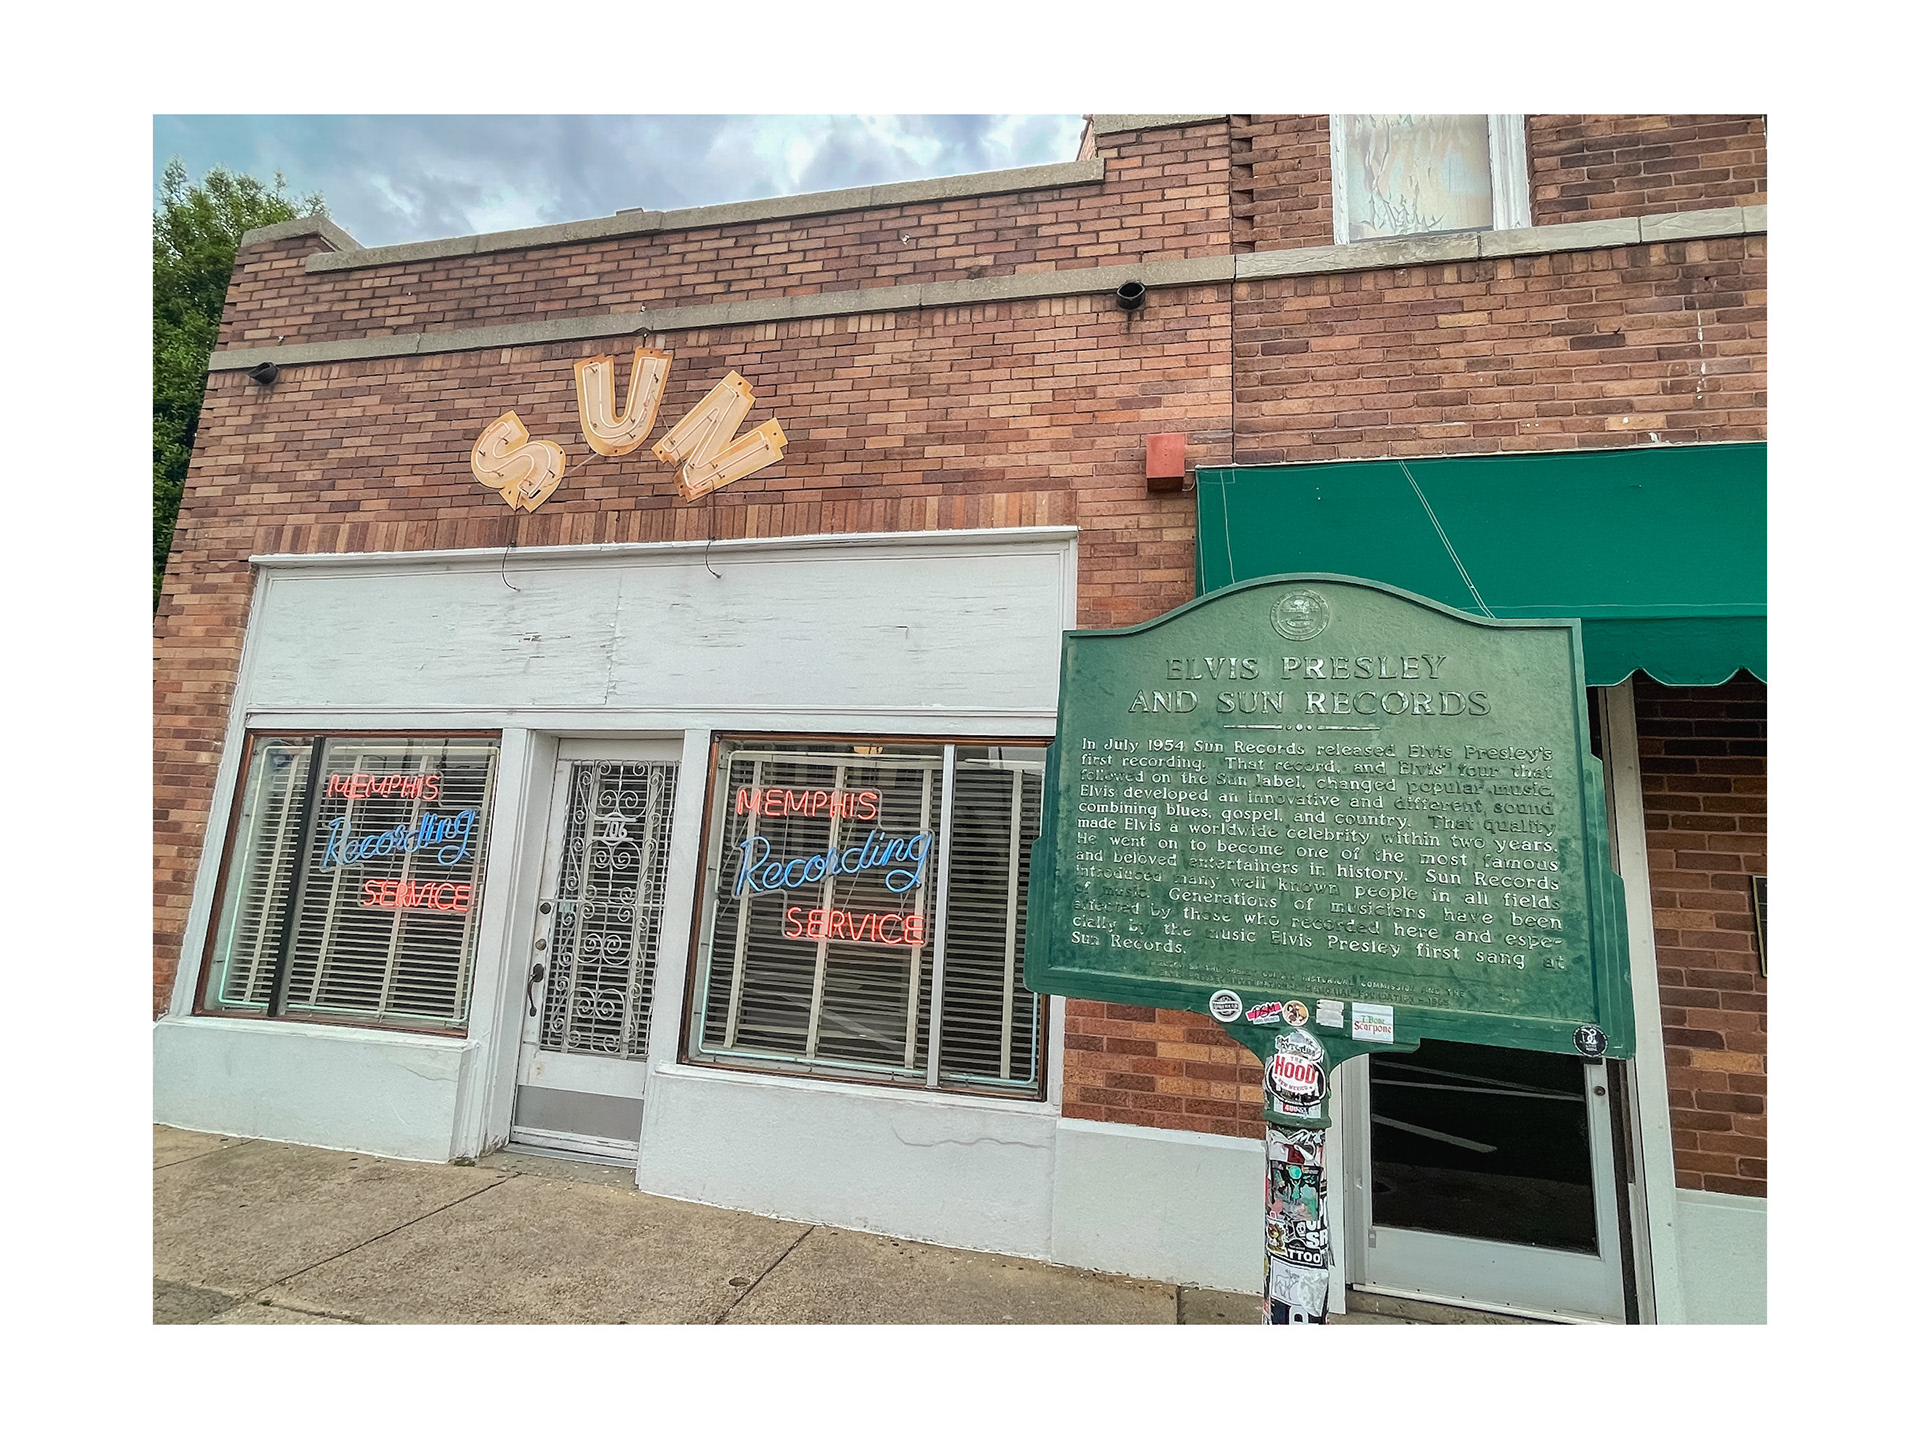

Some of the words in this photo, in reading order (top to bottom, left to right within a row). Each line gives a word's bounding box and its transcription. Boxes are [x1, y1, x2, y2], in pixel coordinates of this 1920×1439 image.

[471, 348, 788, 513] SUN
[1166, 657, 1260, 680] ELVIS
[1281, 654, 1447, 680] PRESLEY
[1128, 689, 1198, 713] AND
[1217, 690, 1284, 714] SUN
[1305, 690, 1491, 716] RECORDS
[1081, 754, 1112, 765] first
[1122, 756, 1206, 771] recording.
[1225, 757, 1264, 771] That
[1354, 761, 1386, 774] and
[1458, 763, 1499, 778] four
[1512, 764, 1553, 779] that
[1082, 738, 1096, 751] In
[1104, 739, 1139, 753] July
[1148, 740, 1185, 752] 1954
[1194, 741, 1224, 753] Sun
[1234, 741, 1305, 755] Records
[1317, 744, 1396, 757] released
[1408, 745, 1452, 759] Elvis
[1464, 745, 1553, 763] Presley's
[327, 773, 441, 800] MEMPHIS
[1080, 769, 1144, 783] followed
[1152, 773, 1171, 783] on
[1181, 772, 1209, 785] the
[1216, 773, 1248, 786] Sun
[1316, 777, 1396, 793] changed
[1406, 780, 1484, 796] popular
[1493, 782, 1554, 797] music.
[736, 788, 879, 821] MEMPHIS
[1080, 785, 1115, 797] Elvis
[1124, 787, 1209, 802] developed
[1219, 792, 1239, 803] an
[1247, 789, 1340, 807] innovative
[1350, 796, 1383, 808] and
[1493, 802, 1554, 815] sound
[602, 821, 628, 838] 706
[1077, 817, 1116, 829] made
[1125, 818, 1161, 832] Elvis
[1170, 823, 1178, 833] a
[1189, 822, 1278, 838] worldwide
[1286, 826, 1370, 844] celebrity
[1383, 831, 1440, 847] within
[1451, 835, 1485, 849] two
[1494, 839, 1558, 854] years.
[1078, 803, 1157, 818] combining
[1293, 811, 1325, 823] and
[1334, 814, 1411, 829] country.
[1428, 815, 1474, 831] That
[1484, 818, 1556, 837] quality
[320, 809, 476, 873] Recording
[1076, 832, 1097, 845] He
[1110, 835, 1146, 847] went
[1158, 839, 1178, 849] on
[1190, 839, 1206, 851] to
[1217, 840, 1284, 855] become
[1296, 846, 1329, 859] one
[1341, 848, 1360, 860] of
[1373, 849, 1404, 863] the
[1419, 852, 1467, 866] most
[1484, 853, 1559, 872] famous
[735, 831, 933, 896] Recording
[1076, 850, 1103, 862] and
[1113, 852, 1177, 867] beloved
[1189, 856, 1298, 874] entertainers
[1309, 862, 1326, 877] in
[1337, 864, 1408, 883] history.
[1425, 869, 1462, 885] Sun
[1474, 872, 1559, 890] Records
[362, 879, 472, 911] SERVICE
[1076, 865, 1162, 883] introduced
[1174, 874, 1219, 889] many
[1231, 876, 1266, 890] well
[1278, 877, 1340, 895] known
[1354, 885, 1418, 902] people
[1431, 888, 1450, 902] in
[1464, 891, 1489, 906] all
[1503, 892, 1561, 910] fields
[1075, 881, 1091, 894] of
[1169, 887, 1277, 908] Generations
[1294, 898, 1315, 911] of
[1331, 901, 1426, 919] musicians
[1443, 908, 1493, 924] have
[1510, 912, 1562, 930] been
[786, 906, 925, 945] SERVICE
[1073, 899, 1139, 915] affected
[1150, 903, 1172, 919] by
[1183, 907, 1232, 922] those
[1244, 912, 1280, 926] who
[1291, 916, 1380, 935] recorded
[1394, 923, 1439, 939] here
[1455, 930, 1491, 944] and
[1504, 934, 1562, 950] espe-
[1071, 931, 1100, 945] Sun
[1110, 934, 1187, 954] Records.
[1073, 915, 1116, 933] cially
[1129, 919, 1149, 934] by
[1164, 923, 1192, 937] the
[1205, 928, 1256, 943] music
[1270, 931, 1312, 947] Elvis
[1328, 936, 1401, 957] Presley
[1416, 943, 1460, 960] first
[1476, 951, 1525, 970] sang
[1543, 955, 1565, 969] at
[1361, 981, 1415, 992] COMMISSION
[1354, 1021, 1392, 1034] Scarpone
[1275, 1055, 1316, 1084] HOOD
[1287, 1249, 1320, 1263] TTOO
